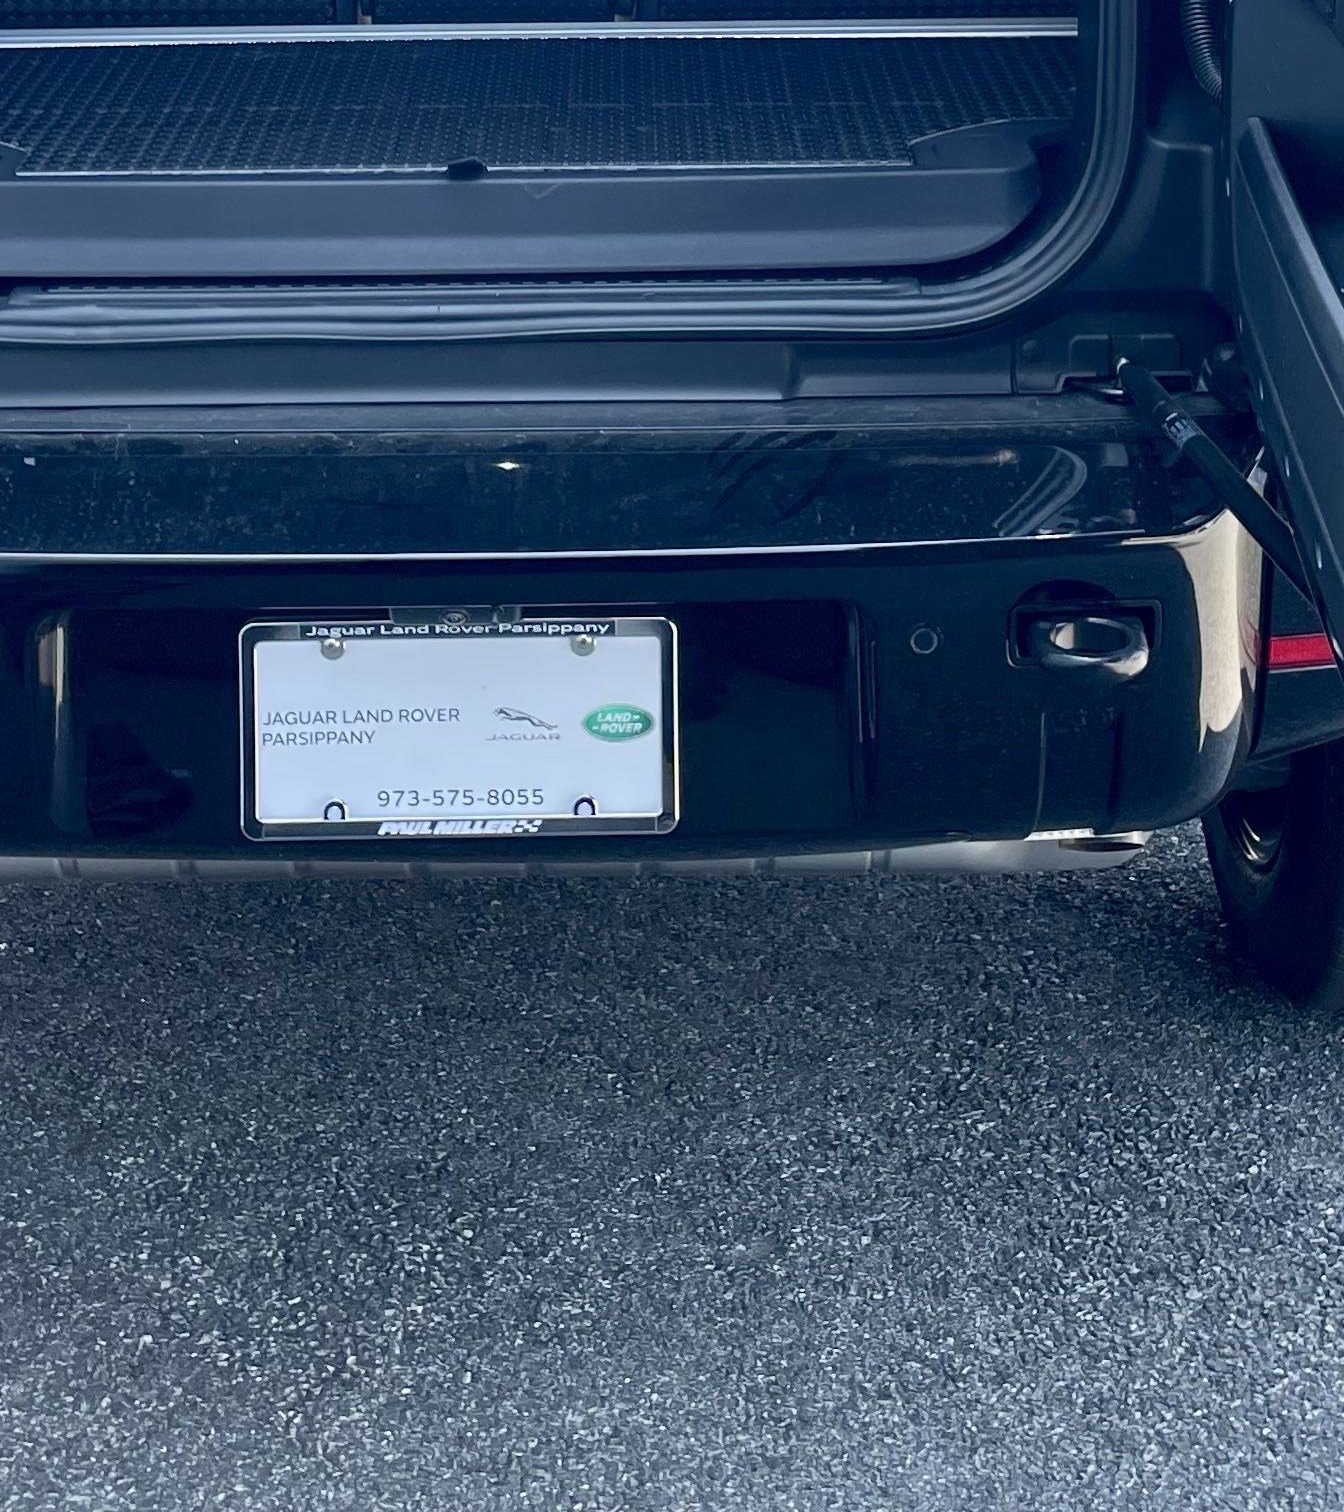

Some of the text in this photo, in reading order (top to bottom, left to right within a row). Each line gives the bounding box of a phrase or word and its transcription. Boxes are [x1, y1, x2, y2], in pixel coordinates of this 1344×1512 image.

[305, 622, 610, 638] Jaguar Land Rover Parsippany
[262, 708, 461, 726] JAGUAR LAND ROVER
[596, 712, 632, 723] LAND
[600, 722, 643, 734] ROVER
[262, 730, 376, 746] PARSIPPANY
[485, 733, 561, 741] JAGUAR
[376, 789, 544, 807] 973-575-8055
[377, 819, 517, 836] PAUL MILLER
